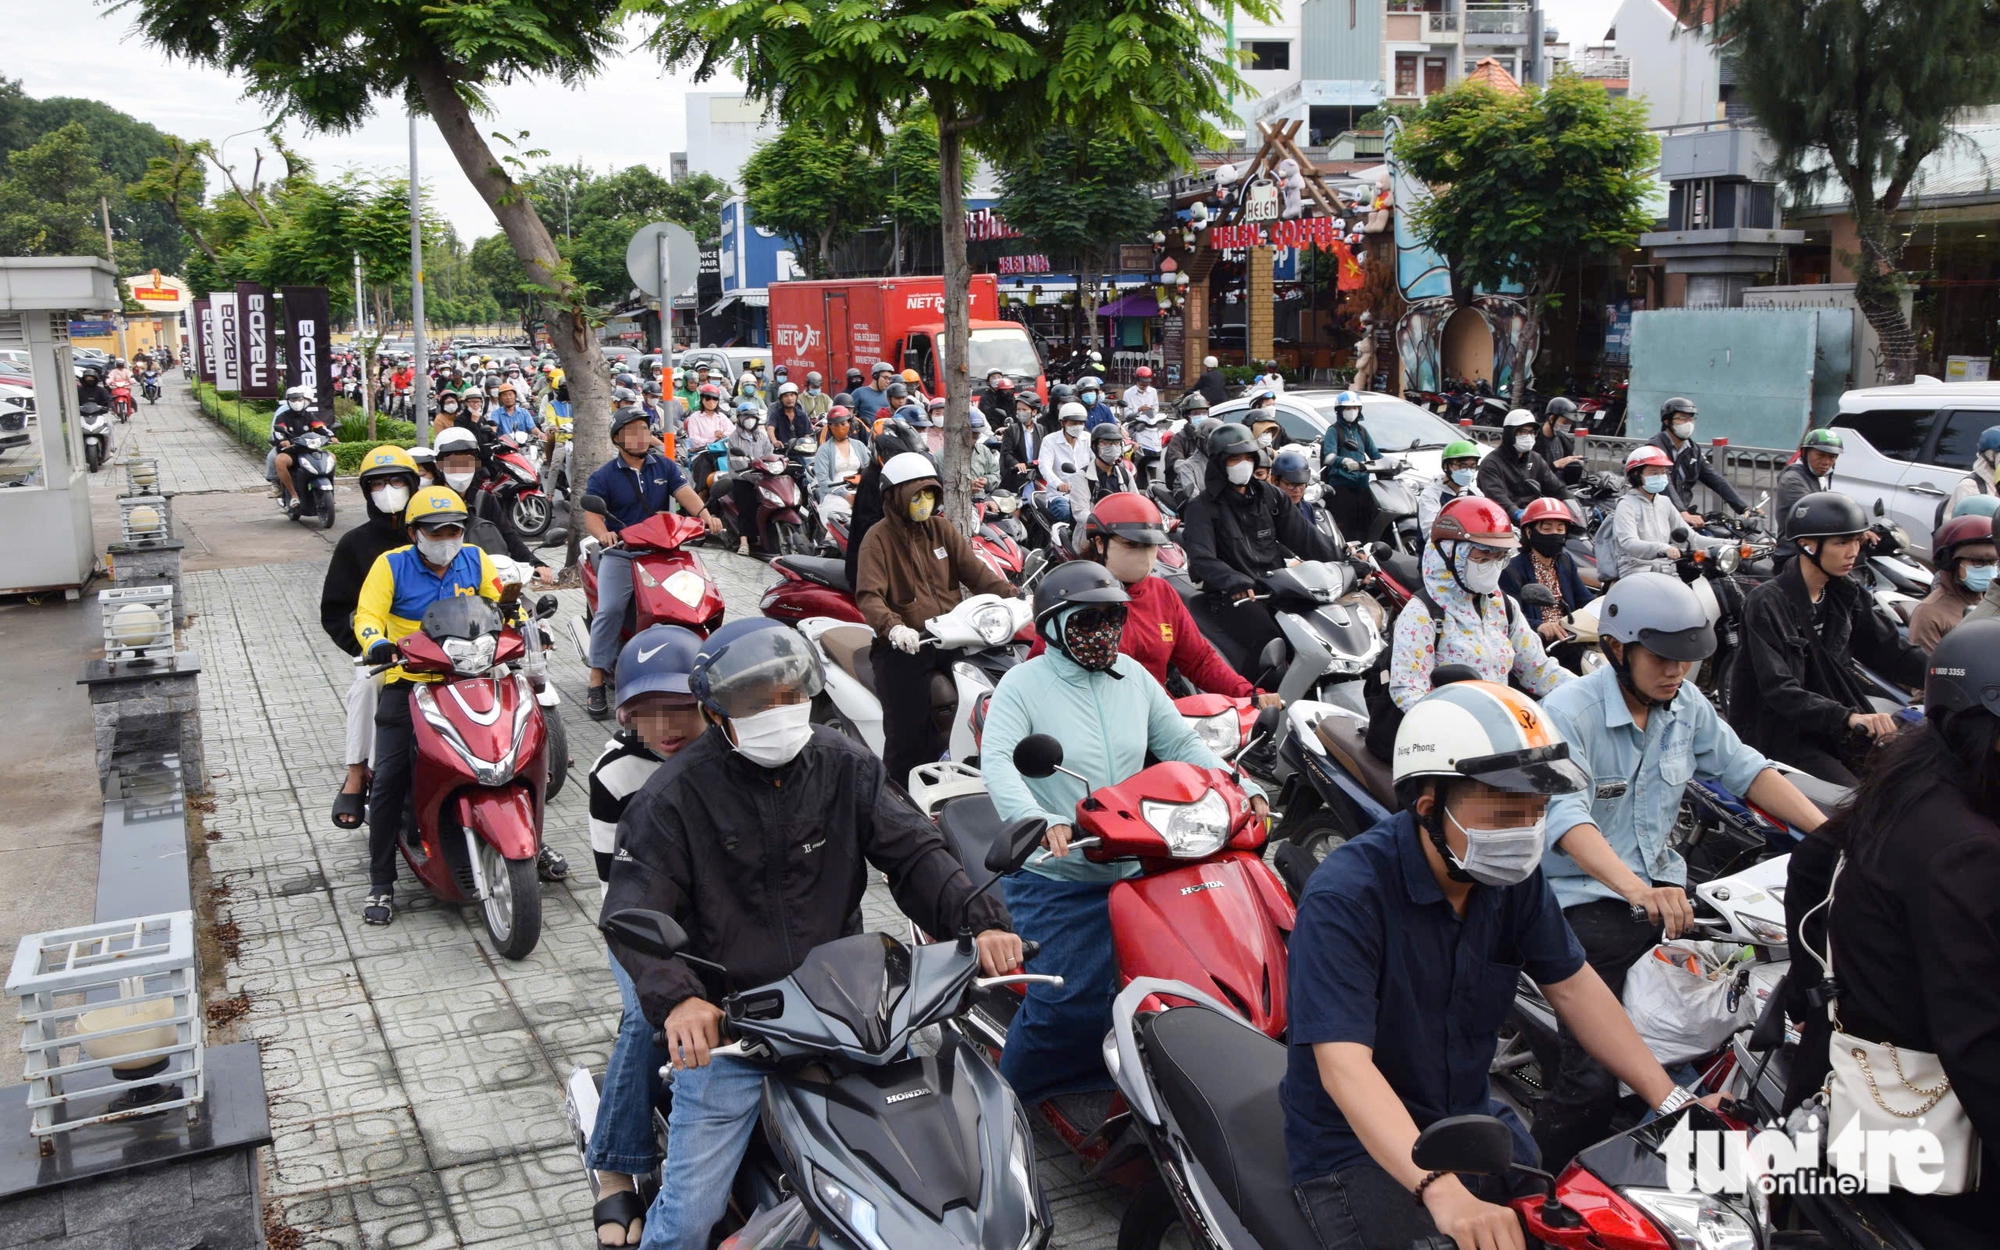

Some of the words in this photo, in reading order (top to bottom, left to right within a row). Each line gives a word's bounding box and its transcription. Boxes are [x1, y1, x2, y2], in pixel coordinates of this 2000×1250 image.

[1248, 200, 1277, 217] HELEN
[1210, 222, 1261, 250] HELEN
[1271, 216, 1334, 248] COFFEE
[999, 256, 1025, 274] HELEN
[906, 297, 933, 309] NET
[248, 294, 267, 387] mazda
[777, 329, 793, 346] NET
[374, 454, 395, 465] be
[429, 496, 452, 509] be
[1412, 743, 1436, 753] Phong
[1180, 880, 1226, 896] HONDA
[885, 1087, 932, 1105] HONDA
